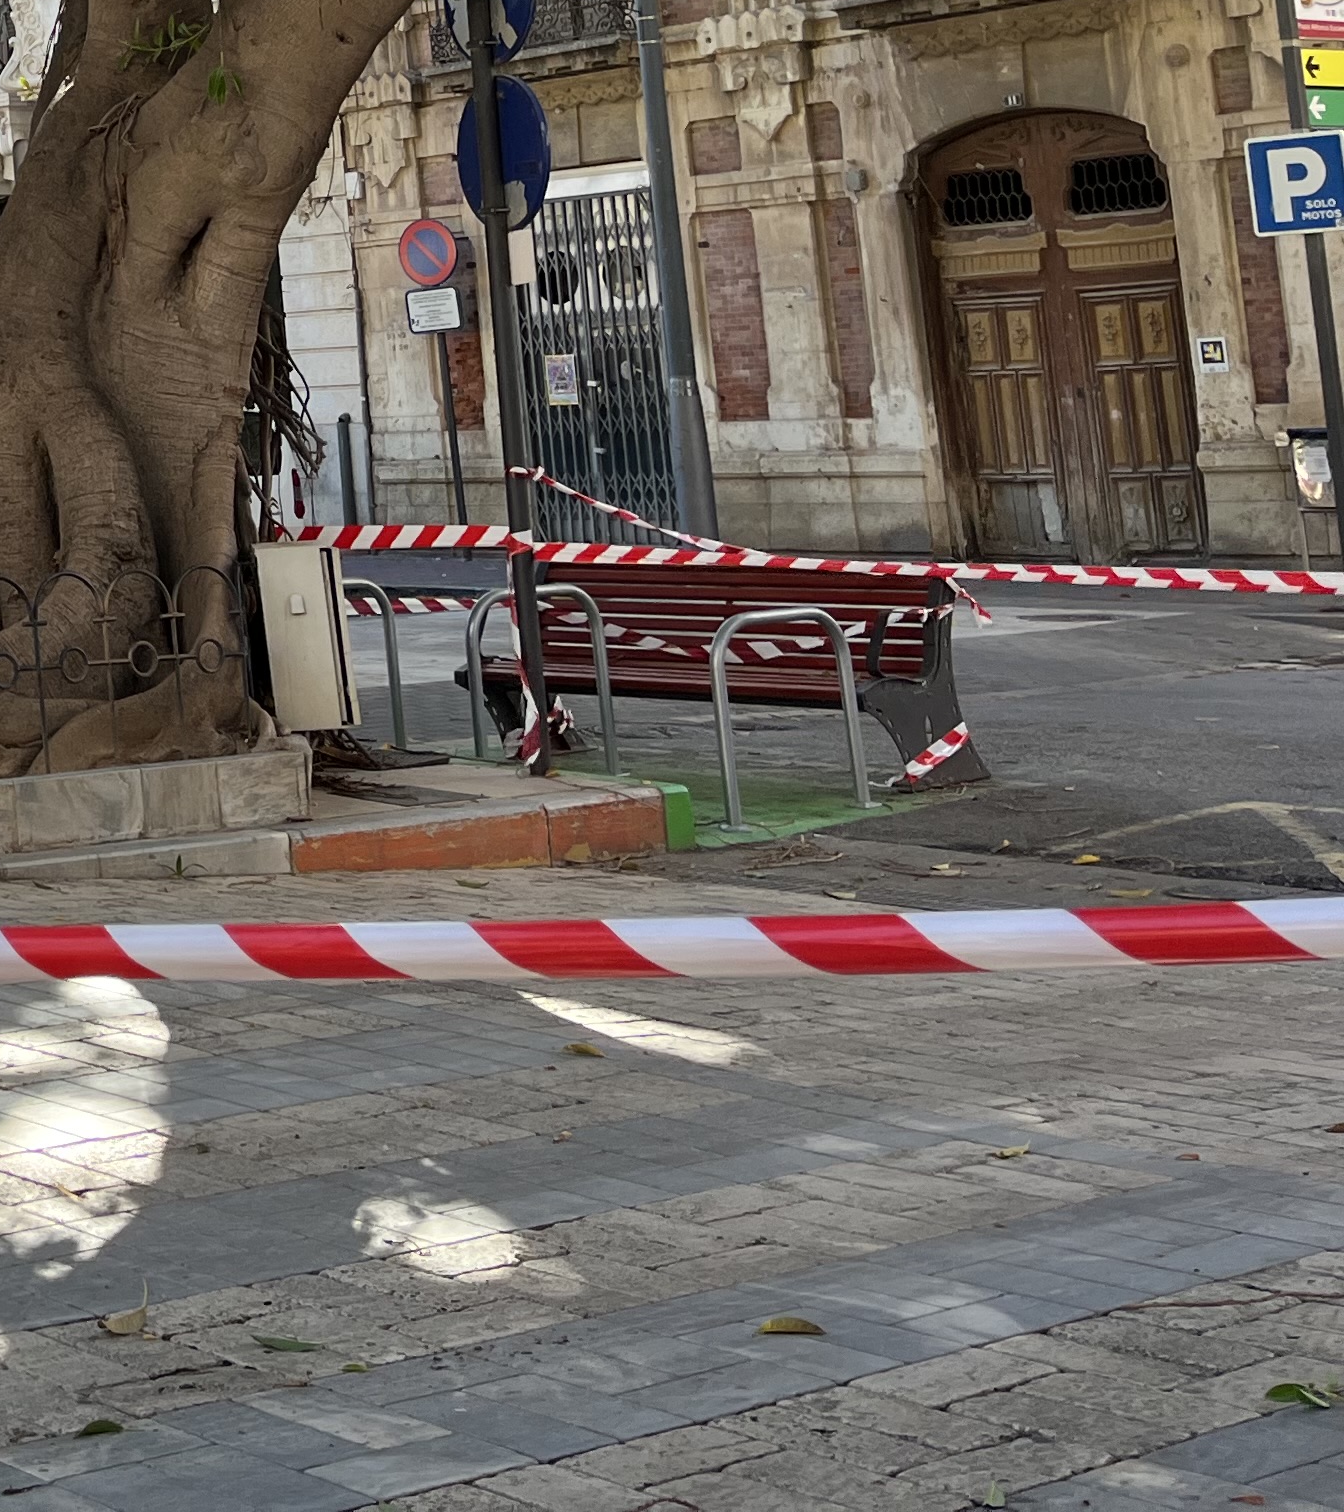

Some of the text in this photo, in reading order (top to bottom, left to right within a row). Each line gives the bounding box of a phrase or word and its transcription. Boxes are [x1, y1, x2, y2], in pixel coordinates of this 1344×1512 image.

[1267, 146, 1327, 223] P
[1305, 198, 1336, 209] SOLO
[1301, 209, 1342, 221] MOTOS
